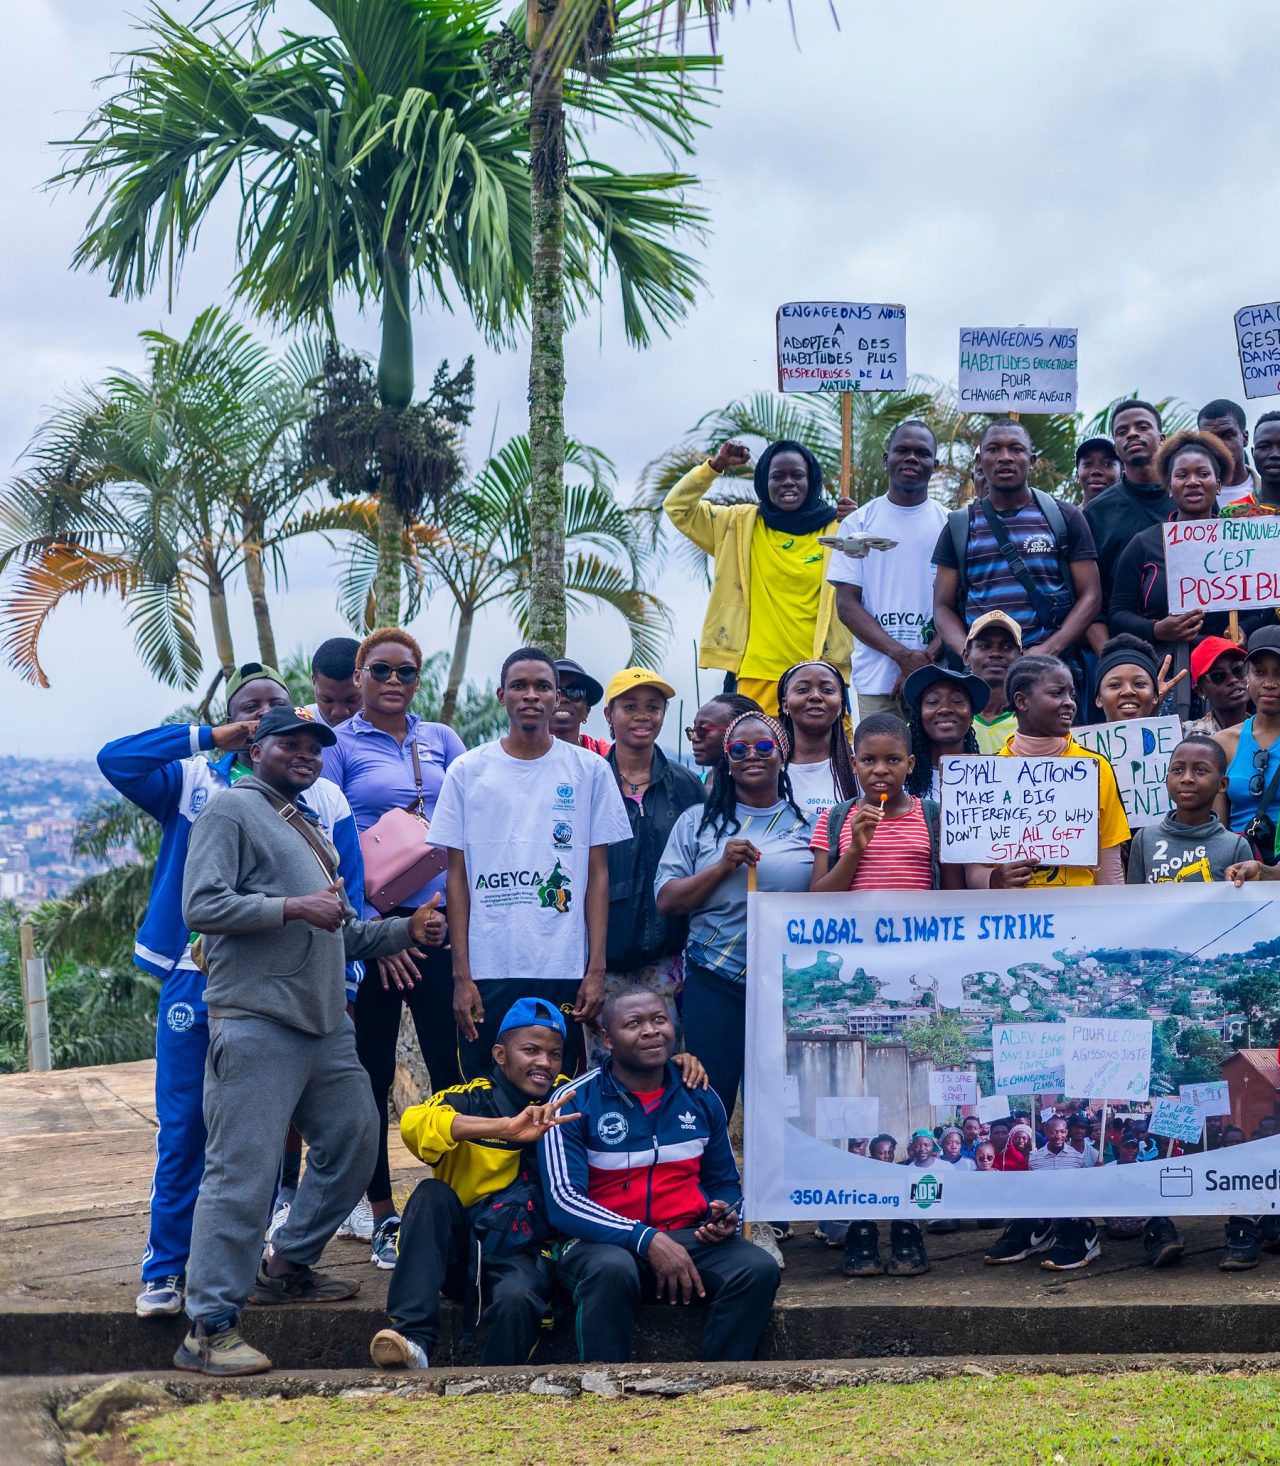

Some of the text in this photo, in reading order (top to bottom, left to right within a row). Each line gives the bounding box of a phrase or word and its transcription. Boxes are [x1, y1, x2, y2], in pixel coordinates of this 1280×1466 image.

[782, 305, 905, 320] ENGAGEONS NOUS
[833, 323, 845, 335] A
[784, 335, 890, 350] ADOPTER DES
[961, 330, 1077, 348] CHANGEONS NOS
[782, 351, 897, 365] HABITUDES PLUS
[960, 351, 1030, 372] HABITUDES
[860, 369, 872, 378] DE
[880, 369, 893, 380] LA
[1001, 373, 1031, 387] POUR
[819, 380, 861, 391] NATURE
[961, 388, 1071, 405] CHANGER NOTRE AVENIR
[1167, 522, 1218, 546] 100%
[1204, 548, 1255, 574] C'EST
[1141, 726, 1174, 756] DE
[943, 760, 1087, 786] SMALL ACTIONS
[956, 788, 1055, 805] MAKE A BIG
[946, 807, 1093, 825] DIFFERENCE, SO WHY
[946, 825, 1085, 847] DON'T WE ALL GET
[986, 843, 1070, 861] STARTED
[1153, 840, 1168, 860] 2
[475, 871, 543, 890] AGEYCA
[786, 914, 1055, 944] GLOBAL CLIMATE STRIKE
